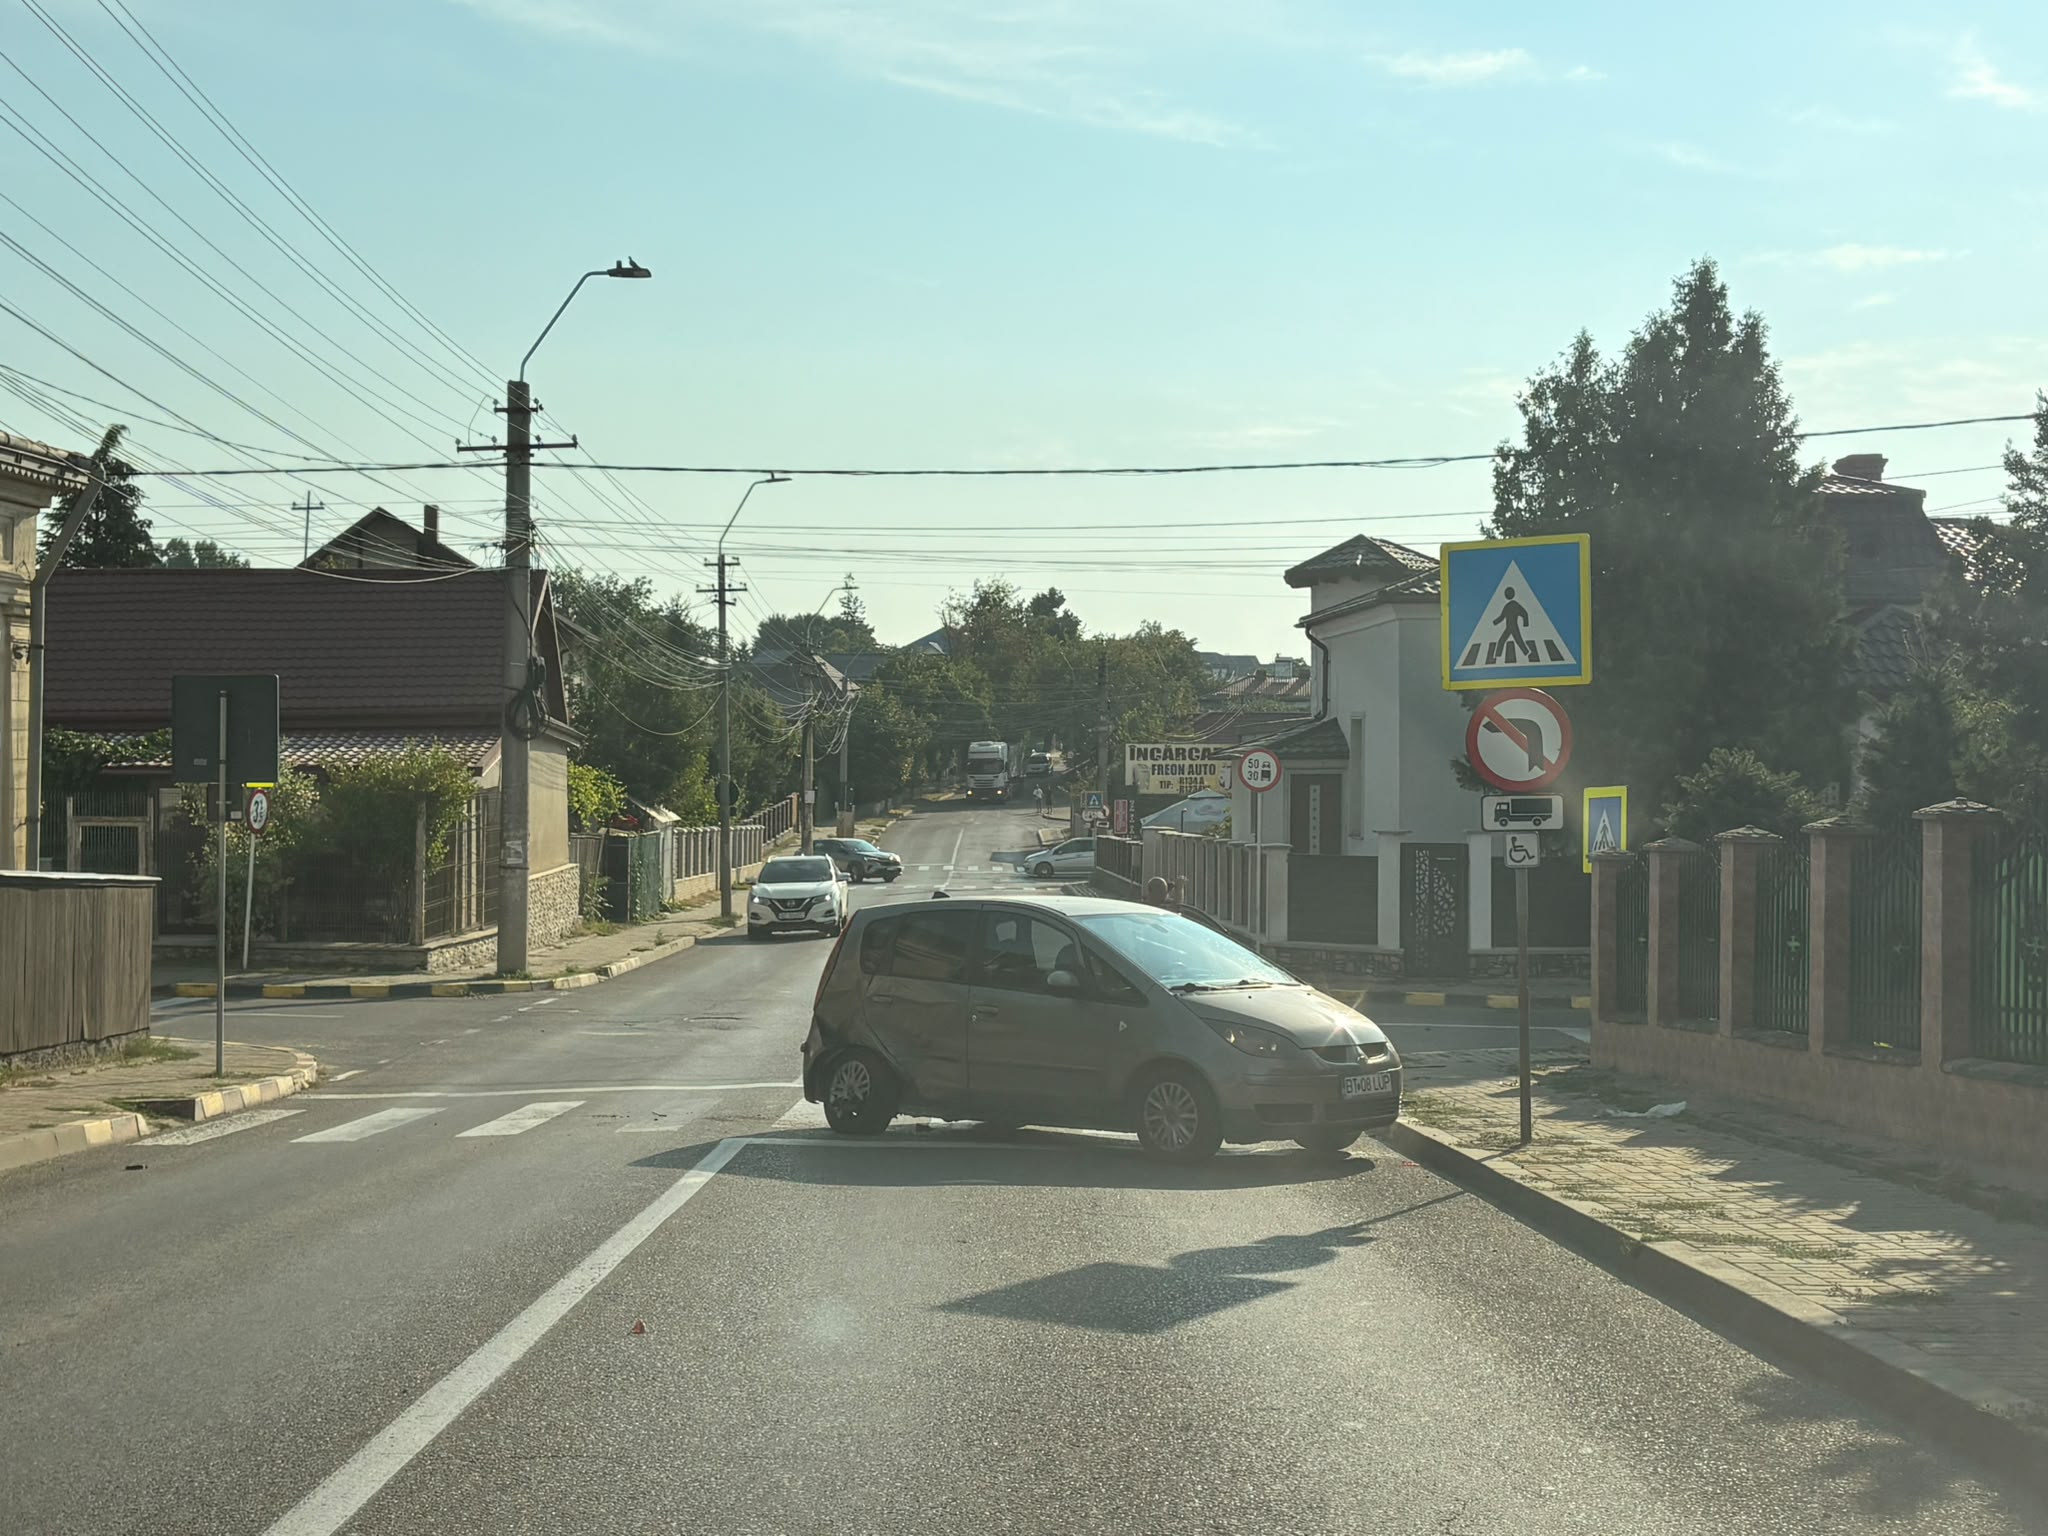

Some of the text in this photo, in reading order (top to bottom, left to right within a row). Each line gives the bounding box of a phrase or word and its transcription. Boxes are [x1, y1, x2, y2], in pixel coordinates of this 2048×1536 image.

[1248, 758, 1259, 768] 50
[1151, 763, 1216, 775] FREON AUTO
[1247, 770, 1258, 780] 30
[1345, 1074, 1390, 1094] BT 08 LUP
